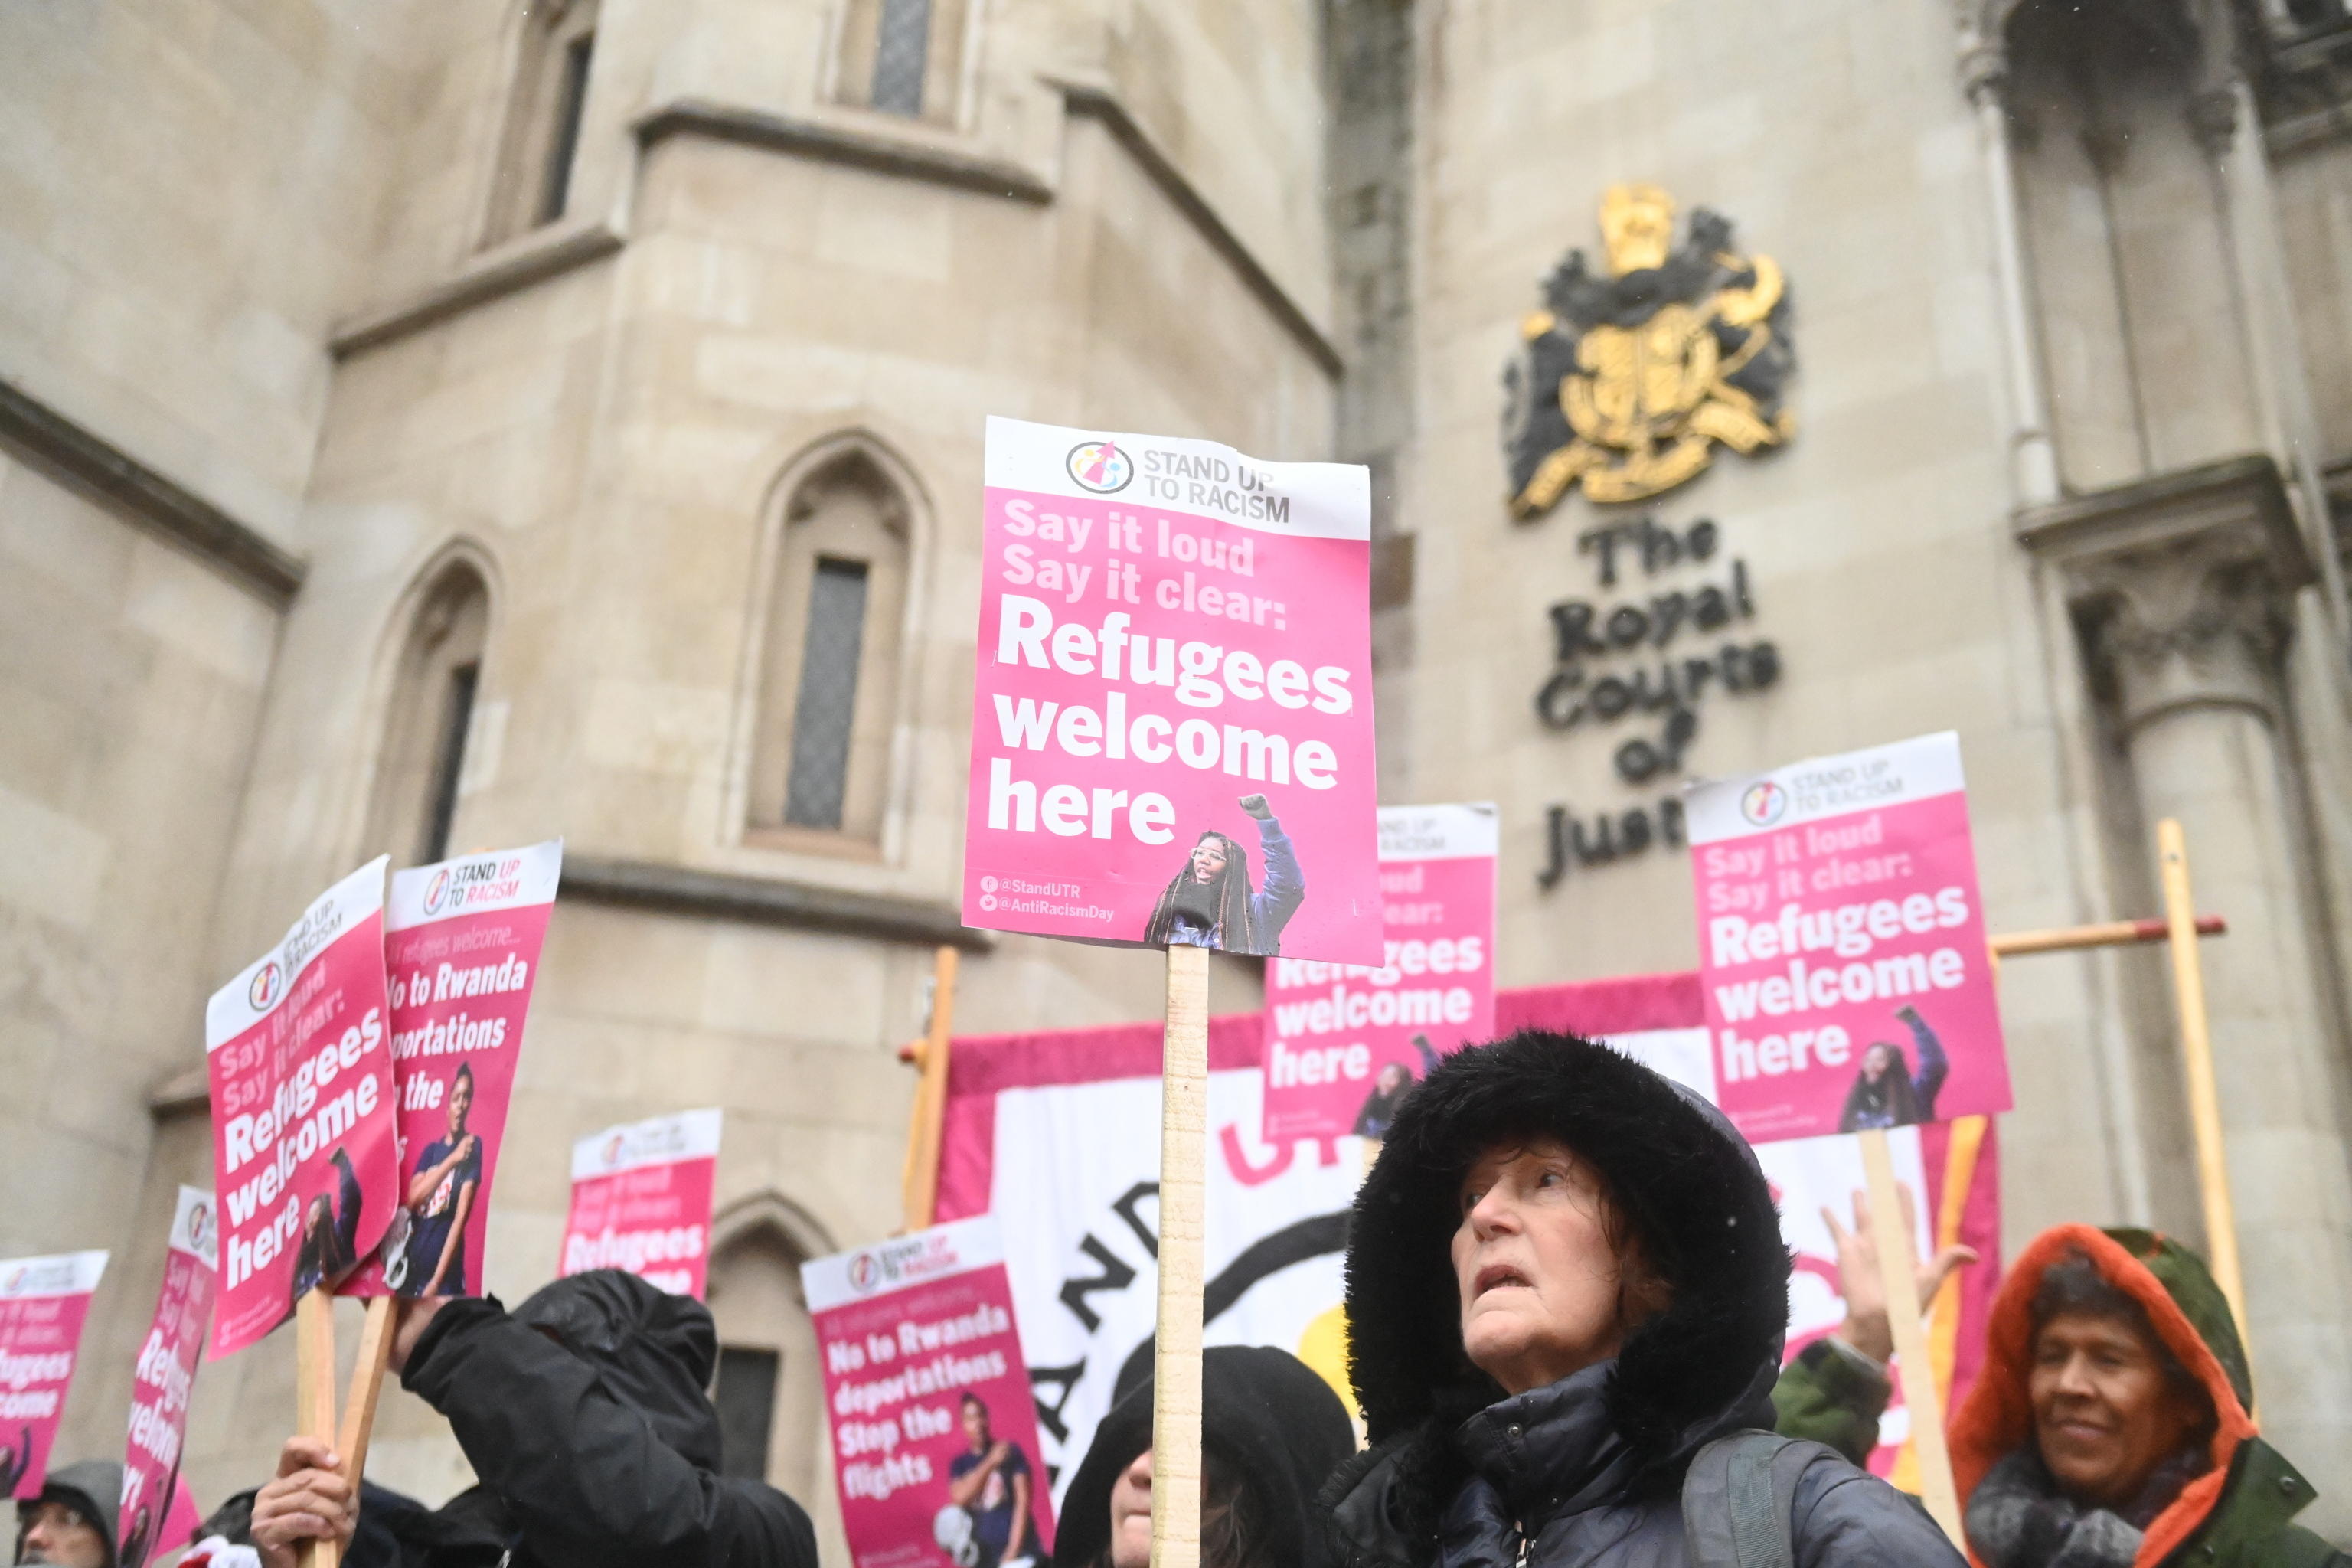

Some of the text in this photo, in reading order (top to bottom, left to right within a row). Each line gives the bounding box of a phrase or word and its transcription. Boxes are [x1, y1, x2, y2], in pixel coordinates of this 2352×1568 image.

[1143, 449, 1274, 492] STAND UP
[1144, 474, 1289, 524] TO RACISM
[1004, 499, 1255, 577] Say it loud
[1578, 518, 1717, 586] The
[1002, 544, 1286, 631] Say it clear:
[1548, 558, 1753, 662] Royal
[998, 593, 1353, 715] Refugees
[992, 691, 1338, 790] welcome
[1614, 707, 1697, 785] of
[988, 757, 1176, 845] here
[454, 858, 521, 883] STAND UP
[1537, 795, 1687, 891] Just
[1705, 813, 1883, 877] Say it loud
[449, 879, 520, 907] TO RACISM
[998, 897, 1114, 923] @AntiRacismDay
[999, 878, 1080, 899] @StandUTR
[1383, 900, 1445, 927] ear:
[1708, 851, 1913, 913] Say it clear:
[1710, 886, 1969, 968] Refugees
[410, 969, 430, 1008] to
[433, 952, 528, 1003] Rwanda
[1274, 983, 1473, 1038] welcome
[1715, 947, 1965, 1024] welcome
[219, 1032, 266, 1080] Say
[273, 1011, 286, 1044] it
[392, 1012, 506, 1060] portations
[1269, 1041, 1371, 1089] here
[1720, 1024, 1851, 1083] here
[222, 1066, 267, 1116] Say
[273, 1050, 287, 1079] it
[225, 1006, 382, 1174] Refugees
[404, 1070, 444, 1112] the
[226, 1073, 379, 1229] welcome
[227, 1193, 300, 1292] here
[828, 1341, 865, 1376] No
[867, 1333, 897, 1364] to
[897, 1302, 1011, 1356] Rwanda
[834, 1350, 1008, 1416] deportations
[838, 1404, 952, 1456] Stop the
[843, 1452, 933, 1501] flights
